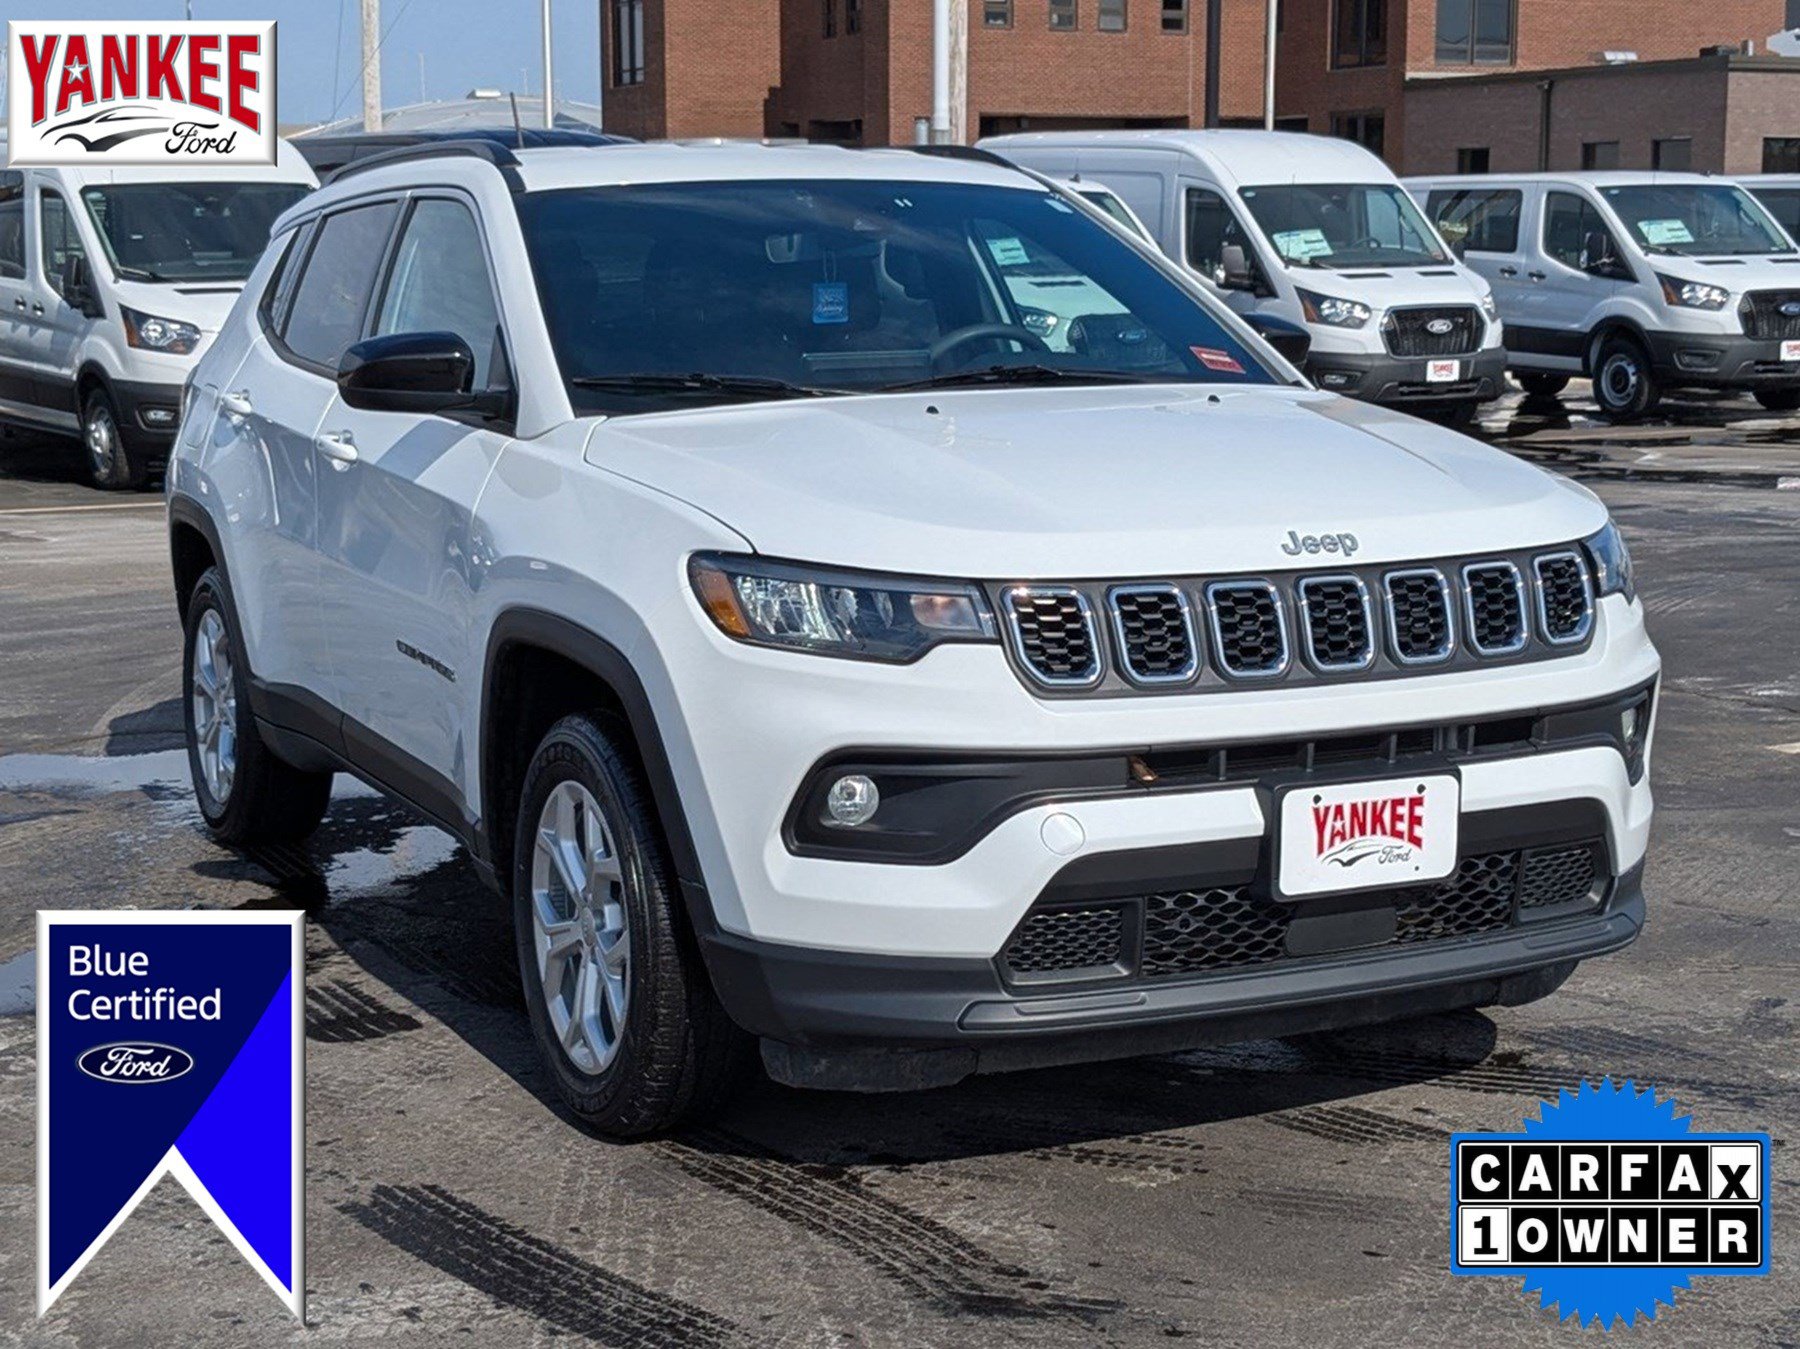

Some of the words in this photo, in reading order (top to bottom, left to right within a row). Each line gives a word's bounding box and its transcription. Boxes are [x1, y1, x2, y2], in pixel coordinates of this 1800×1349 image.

[1281, 531, 1359, 556] Jeep
[1312, 795, 1425, 858] YANKEE
[1378, 845, 1412, 865] Ford
